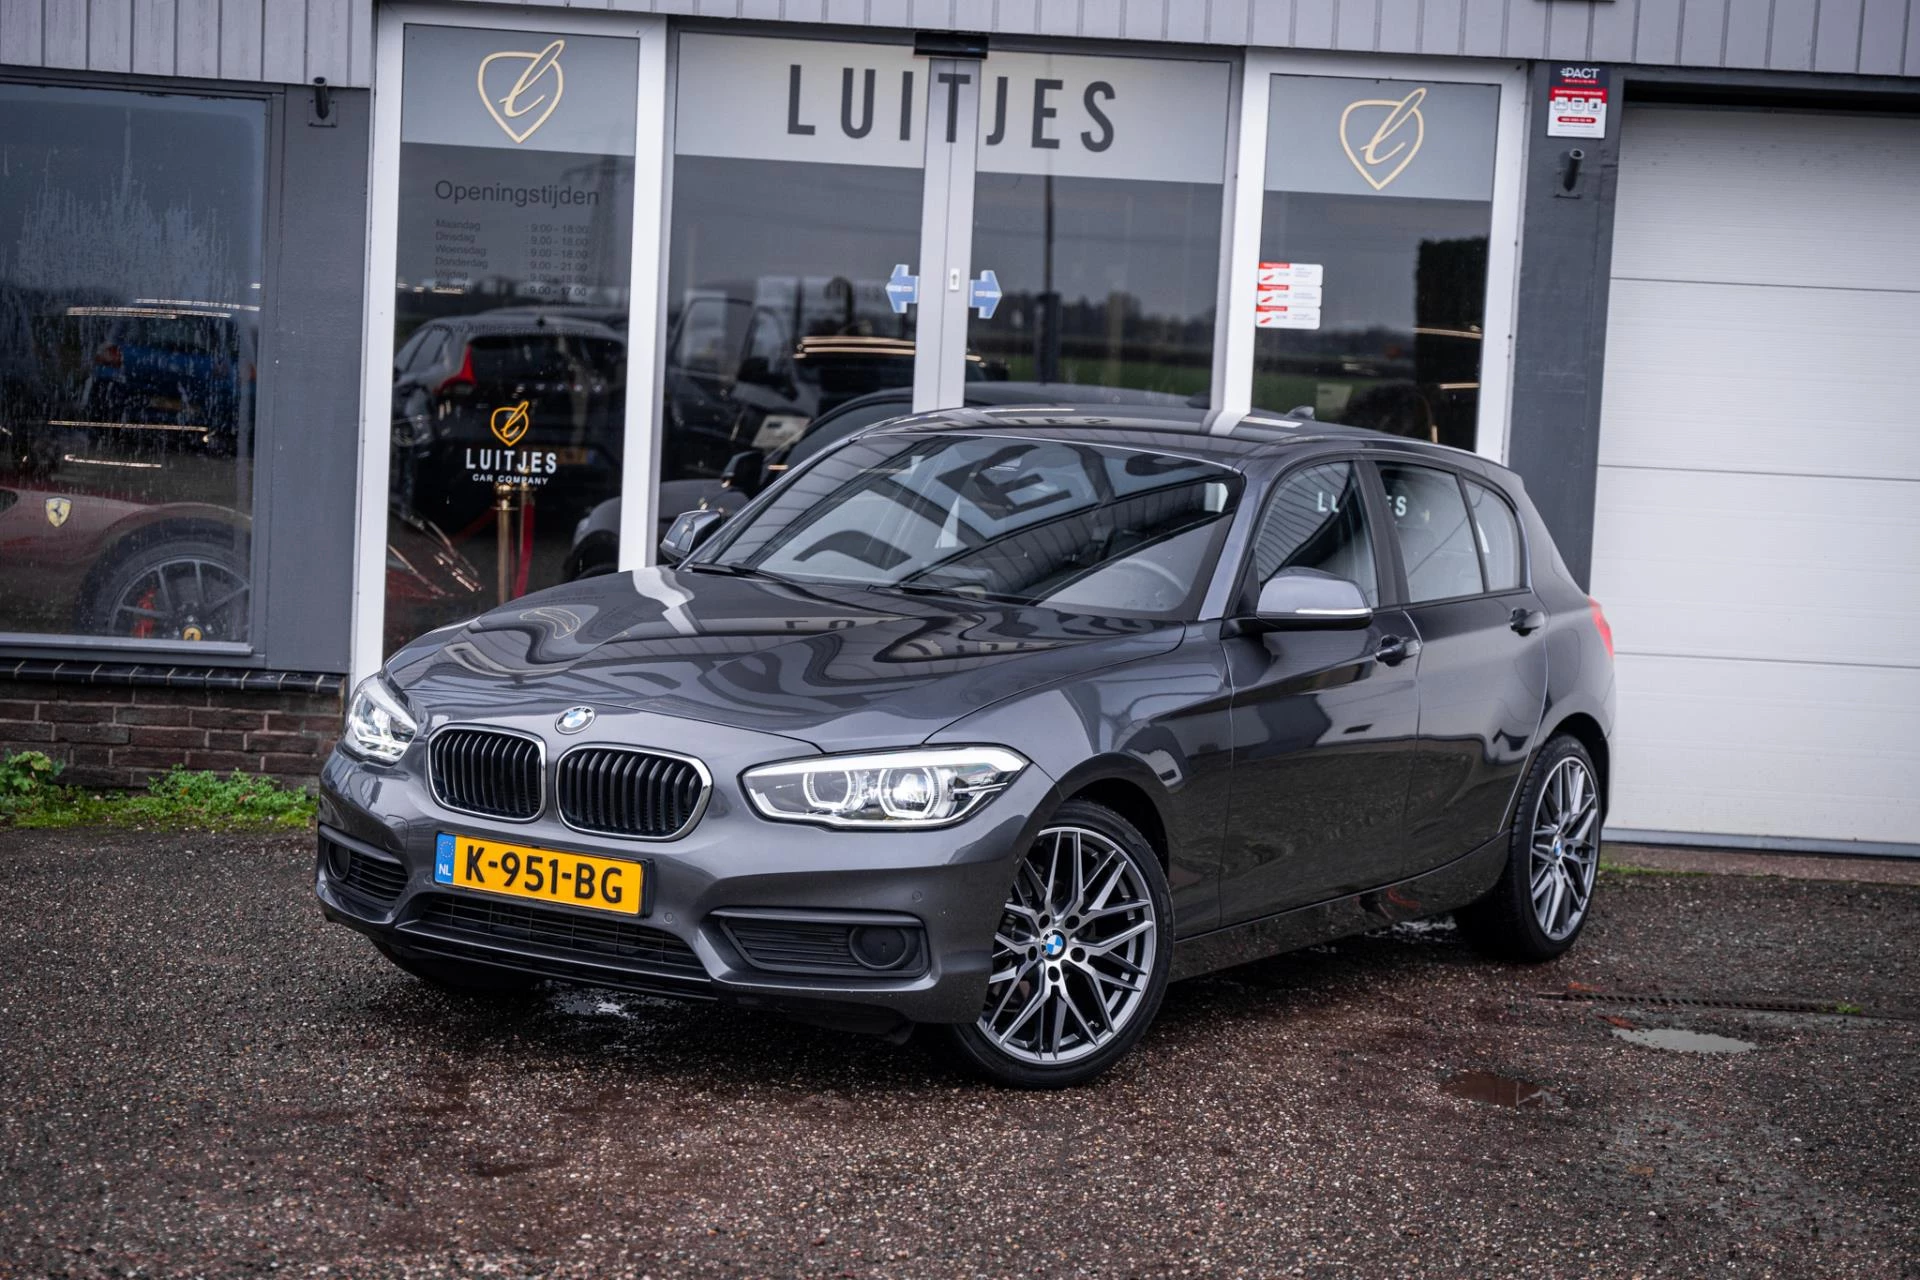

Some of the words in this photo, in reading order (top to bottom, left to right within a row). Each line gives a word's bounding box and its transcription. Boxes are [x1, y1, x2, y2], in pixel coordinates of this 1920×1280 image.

[787, 64, 1116, 153] LUITJES
[434, 179, 600, 209] Openingstijden
[466, 448, 557, 474] LUITJES
[472, 473, 493, 482] CAR
[497, 474, 549, 485] COMPANY
[438, 863, 452, 877] NL
[465, 845, 623, 904] K-951-BG
